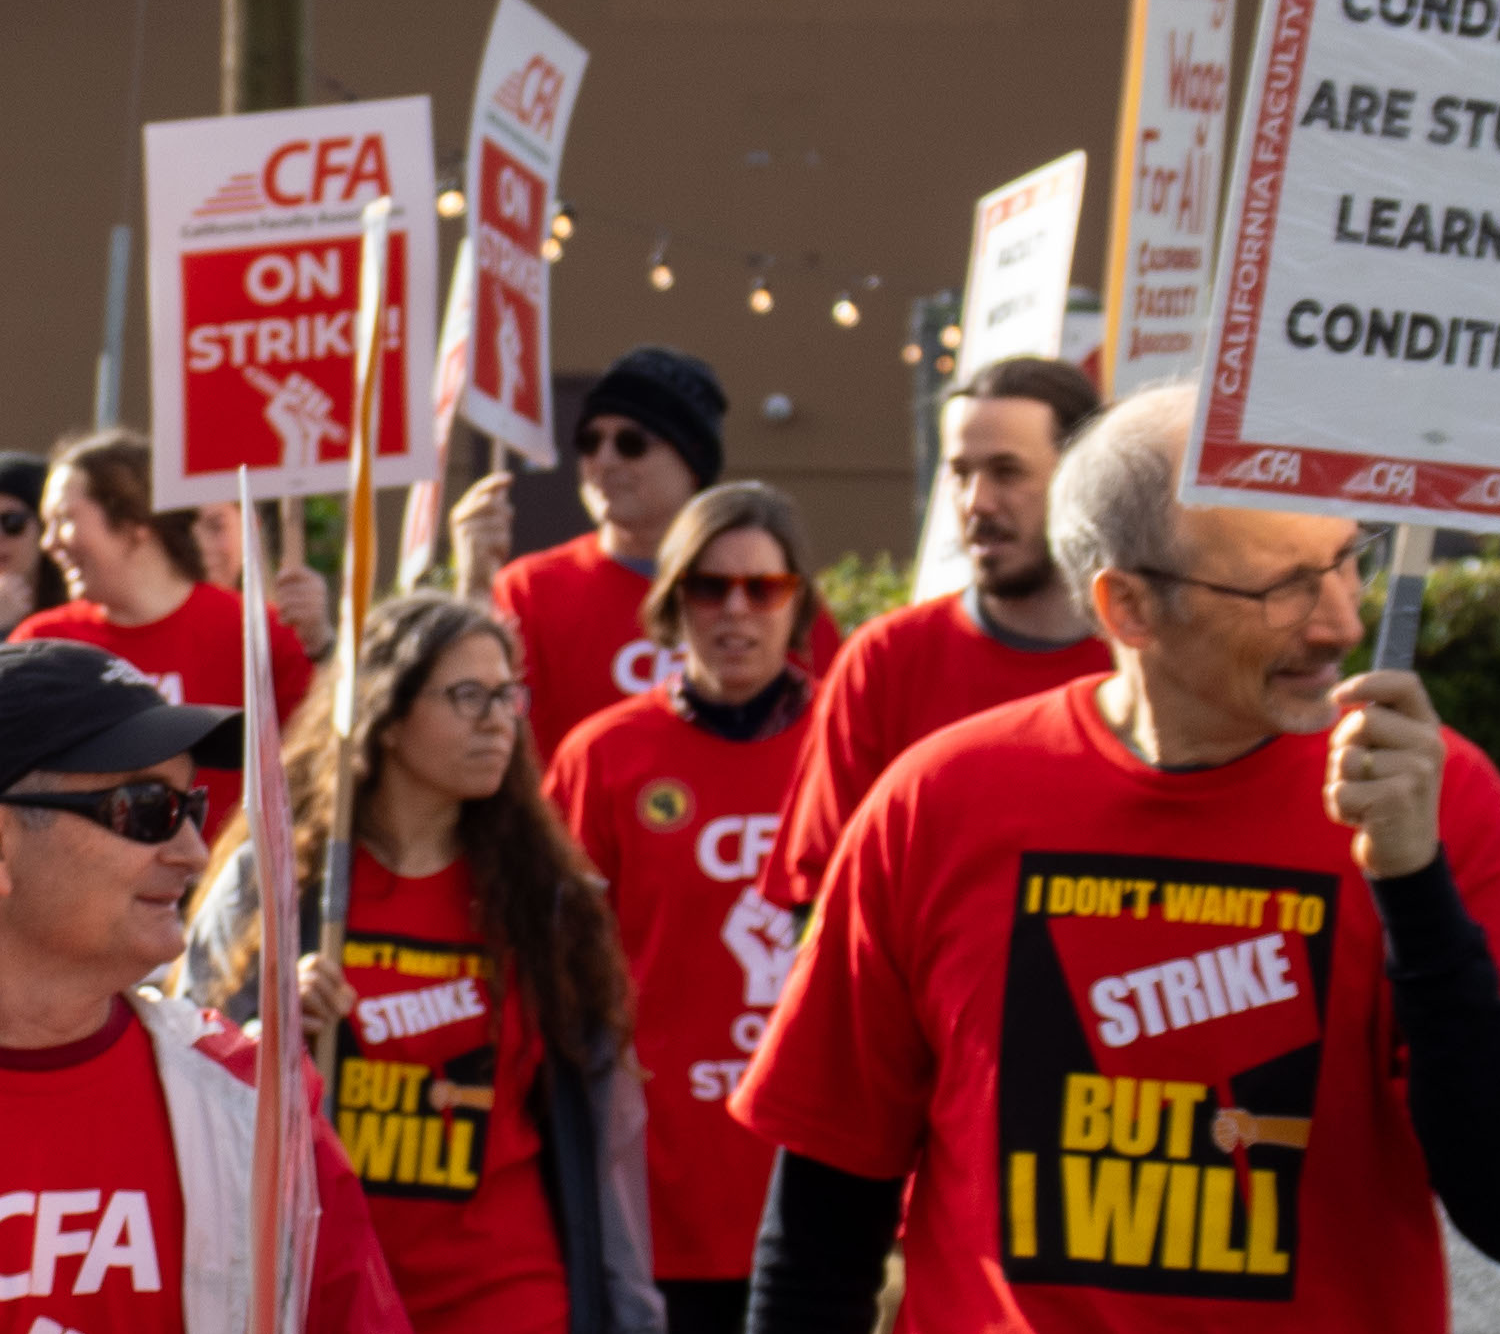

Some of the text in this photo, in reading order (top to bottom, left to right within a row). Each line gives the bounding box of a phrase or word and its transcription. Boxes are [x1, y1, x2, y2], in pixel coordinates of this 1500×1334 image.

[1300, 78, 1417, 142] ARE
[261, 132, 393, 209] CFA
[243, 247, 343, 307] ON
[1217, 170, 1280, 397] CALIFORNIA
[187, 307, 401, 374] STRIK!
[1252, 448, 1300, 486] CFA
[1367, 460, 1418, 499] CFA
[1024, 874, 1327, 937] I DON'T WANT TO
[356, 976, 488, 1046] STRIKE
[1087, 931, 1300, 1049] STRIKE
[340, 1055, 432, 1114] BUT
[1060, 1071, 1208, 1161] BUT
[338, 1110, 479, 1191] WILL
[1008, 1150, 1291, 1276] I WILL
